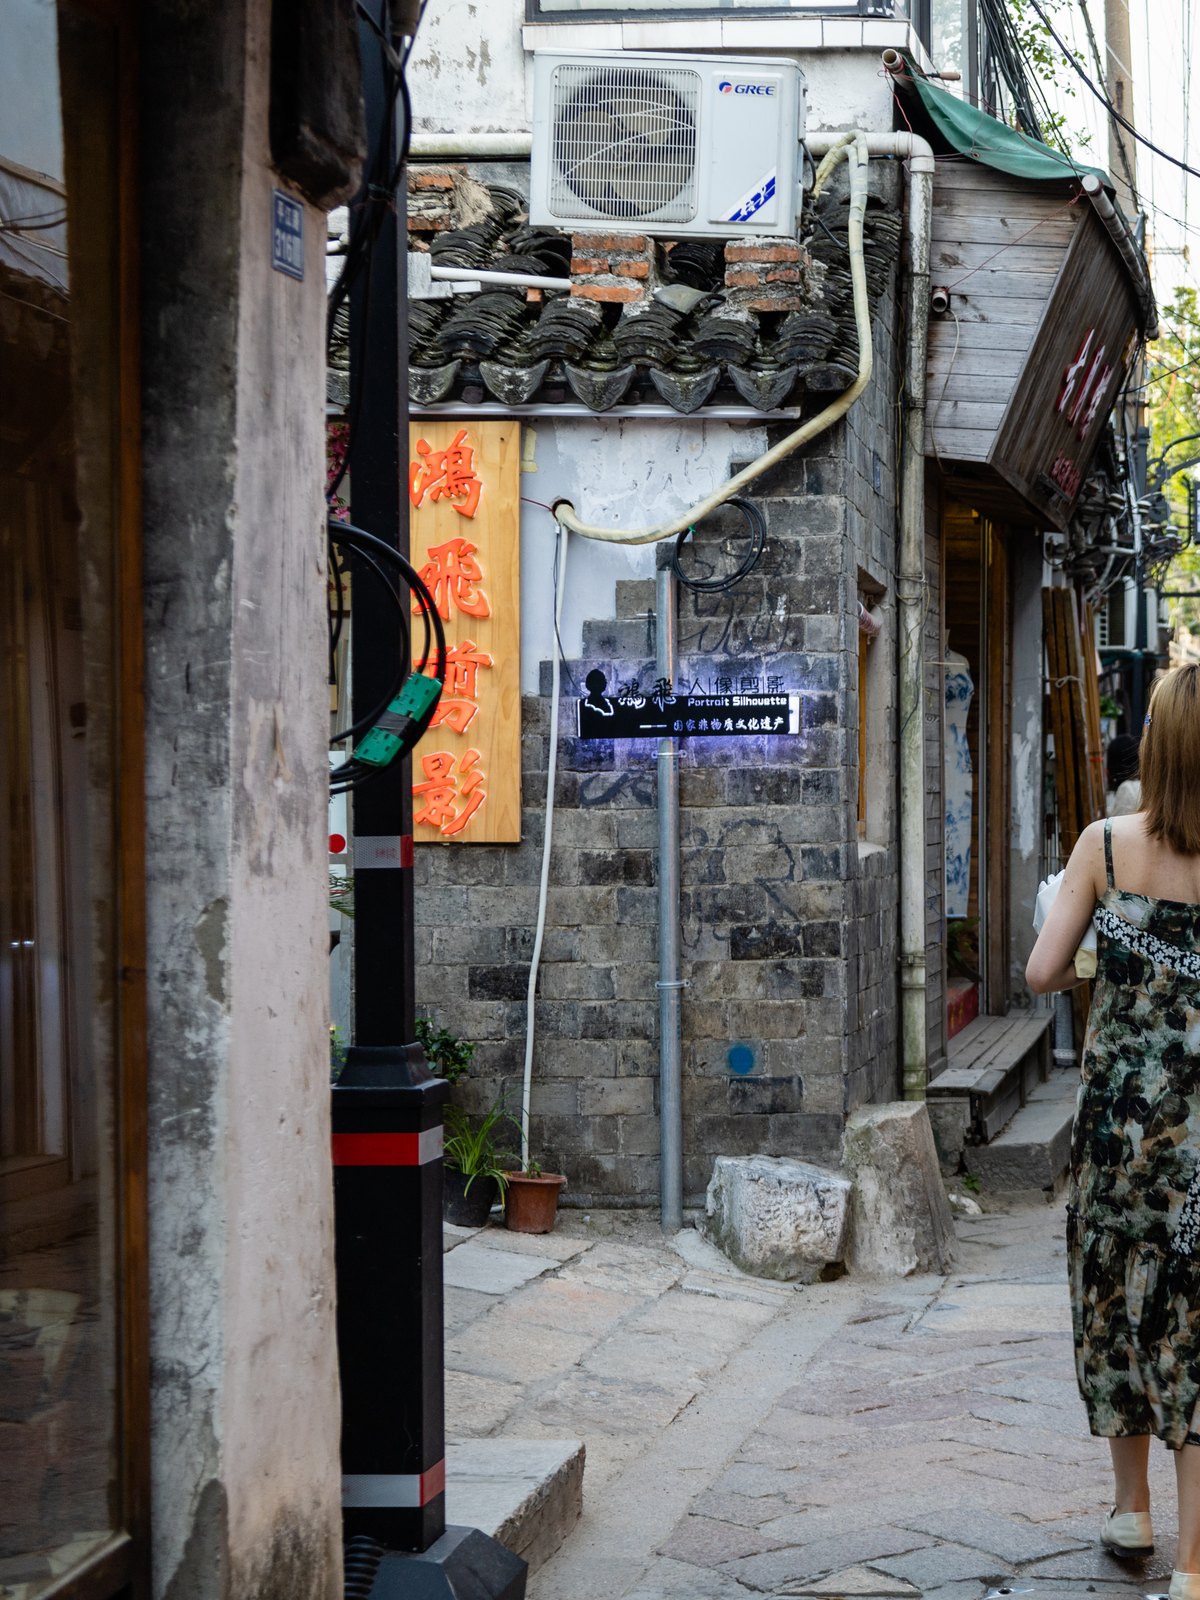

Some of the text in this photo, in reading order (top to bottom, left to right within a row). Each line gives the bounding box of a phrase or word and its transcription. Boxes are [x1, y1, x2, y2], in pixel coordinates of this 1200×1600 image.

[734, 84, 775, 96] GREE
[687, 695, 787, 707] Portrait Silhouette
[673, 716, 784, 732] 国家非物质文化遗产
